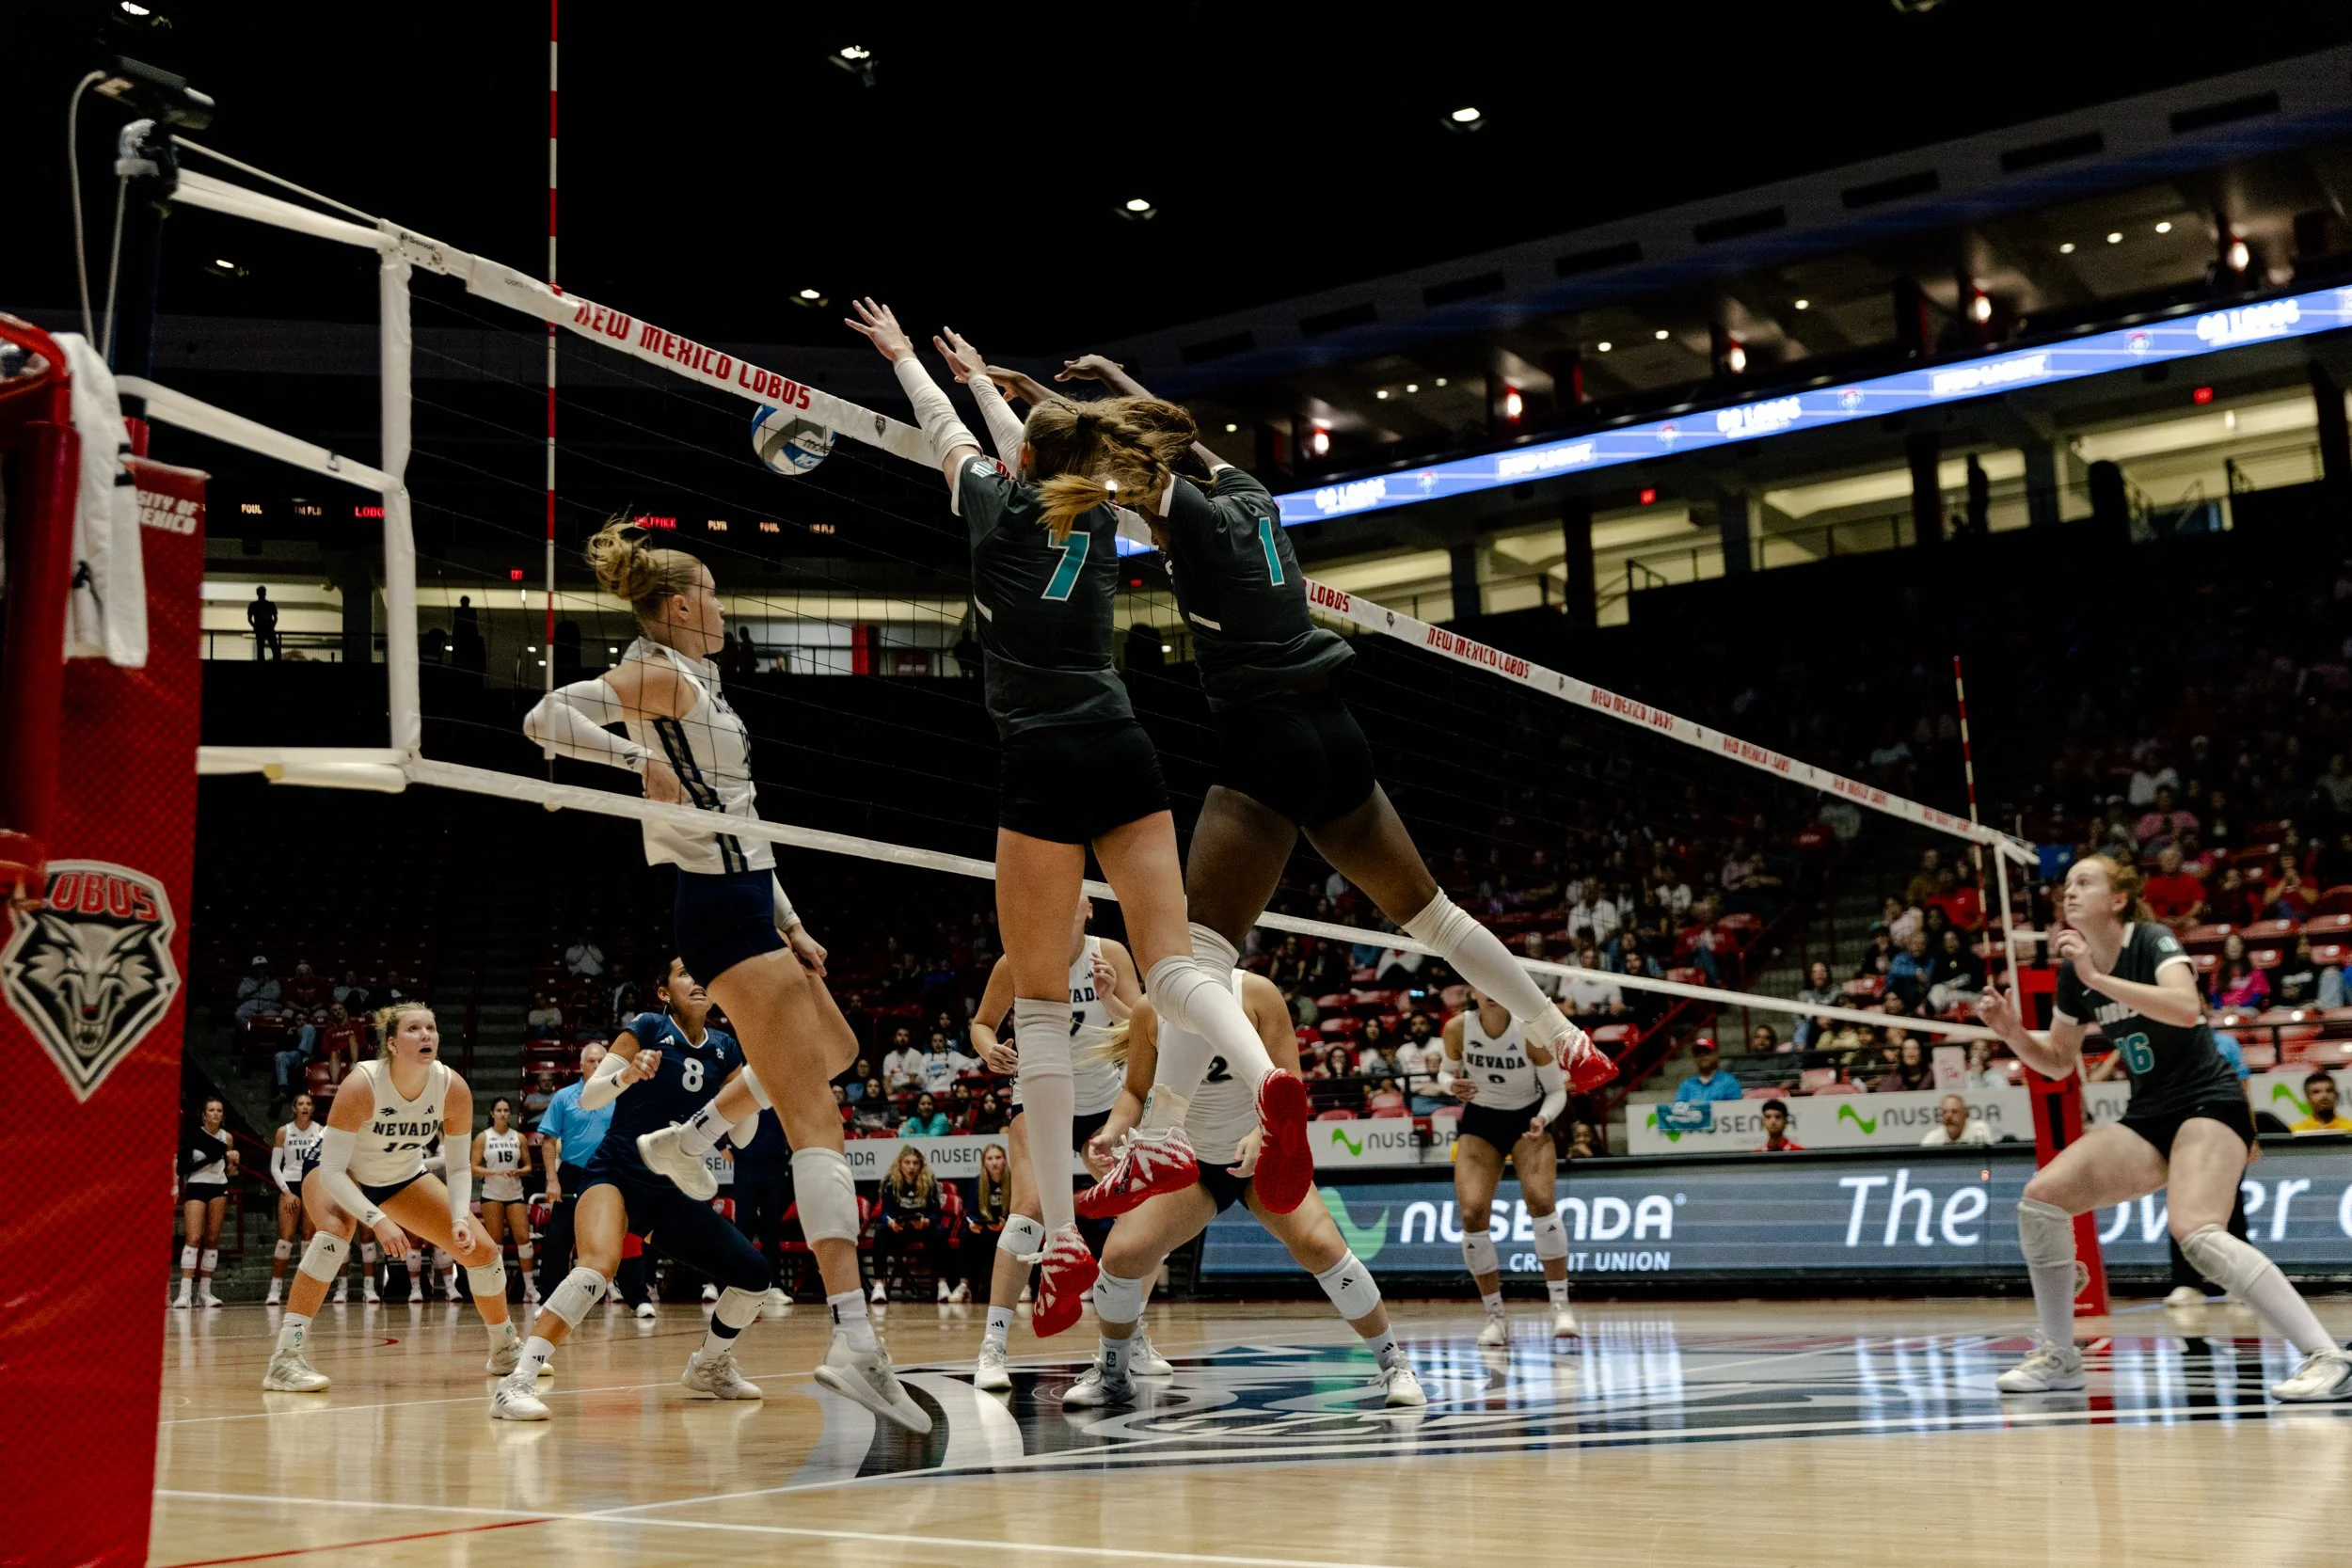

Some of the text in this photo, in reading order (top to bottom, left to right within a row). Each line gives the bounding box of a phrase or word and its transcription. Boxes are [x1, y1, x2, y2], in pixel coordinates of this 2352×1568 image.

[574, 300, 810, 410] NEW MEXICO LOBOS
[138, 507, 197, 535] EXICO
[241, 503, 262, 515] FOUL
[355, 505, 385, 518] LOBO
[1041, 529, 1090, 601] 7
[1259, 516, 1284, 586] 1
[1310, 581, 1350, 612] LOBOS
[1426, 626, 1530, 679] NEW MEXICO LOBOS
[51, 871, 159, 922] OBOS
[682, 1057, 704, 1092] 8
[1466, 1053, 1526, 1069] NEVADA
[498, 1151, 514, 1163] 15
[931, 1148, 981, 1164] NUSEN
[1838, 1169, 1989, 1246] The
[1509, 1252, 1670, 1272] CRIT UNION
